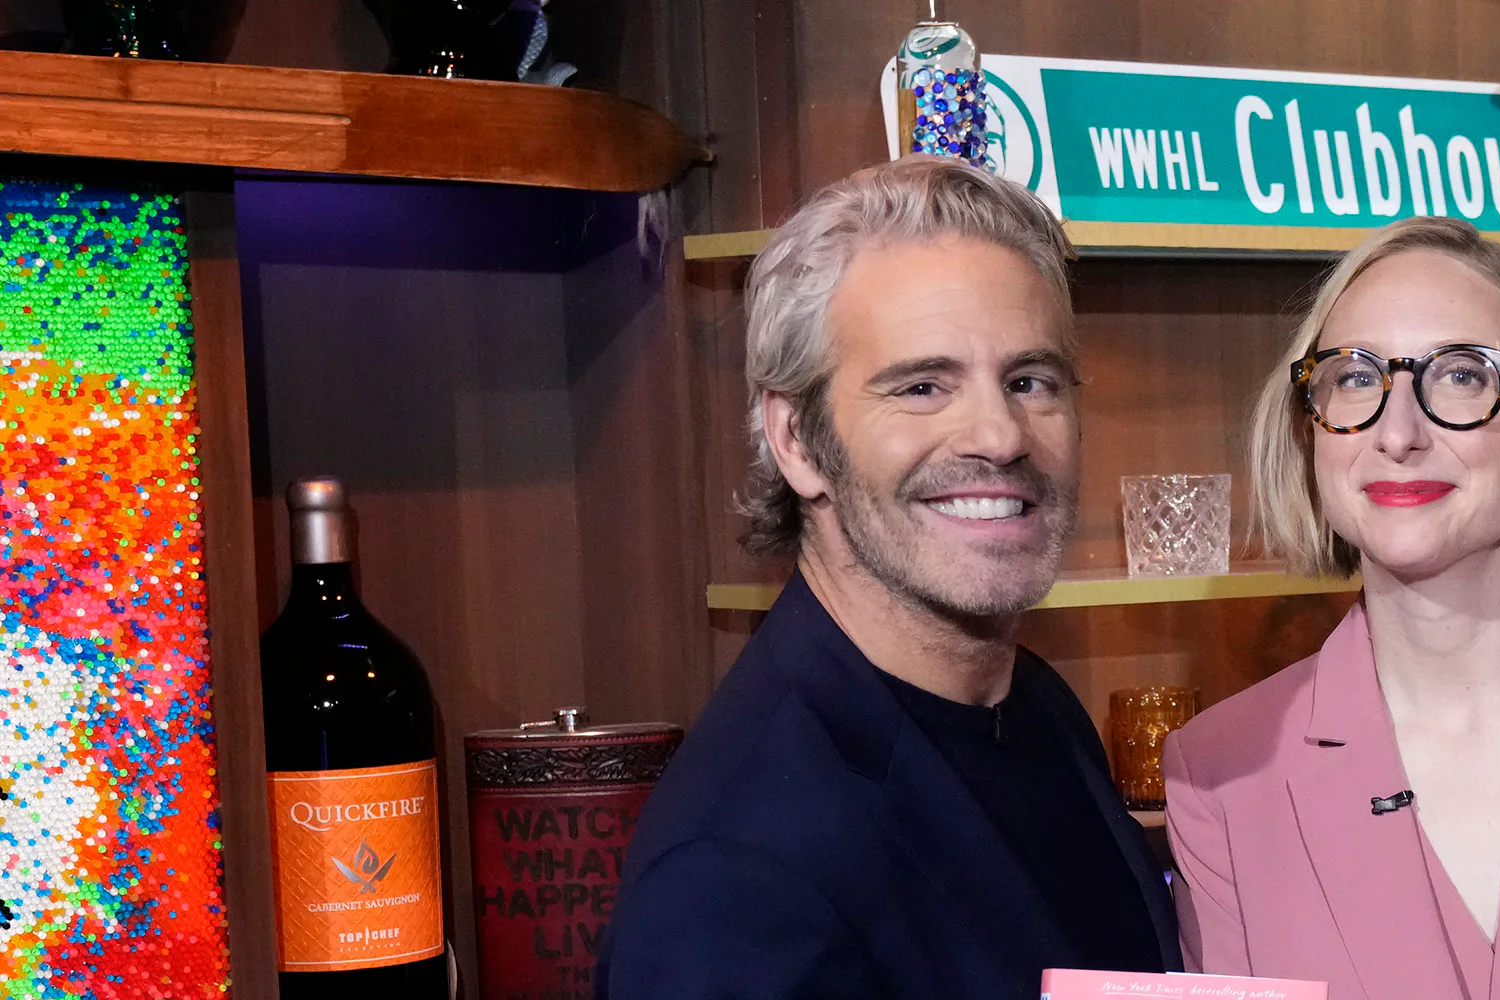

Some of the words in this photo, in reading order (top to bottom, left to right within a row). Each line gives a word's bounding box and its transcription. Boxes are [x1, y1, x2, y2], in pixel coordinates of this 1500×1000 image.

[1089, 126, 1219, 191] WWHL
[290, 797, 421, 831] QUICKFIRE
[308, 901, 363, 913] CABERNET
[365, 893, 420, 909] SAUVIGNON
[475, 883, 619, 919] HAPPE
[339, 932, 363, 943] TOP
[371, 928, 400, 941] CHEF
[534, 922, 608, 957] LIV
[1101, 981, 1126, 992] New
[1129, 982, 1151, 993] York
[1156, 984, 1184, 995] Times
[1190, 985, 1246, 1000] bestselling
[1249, 990, 1287, 999] author
